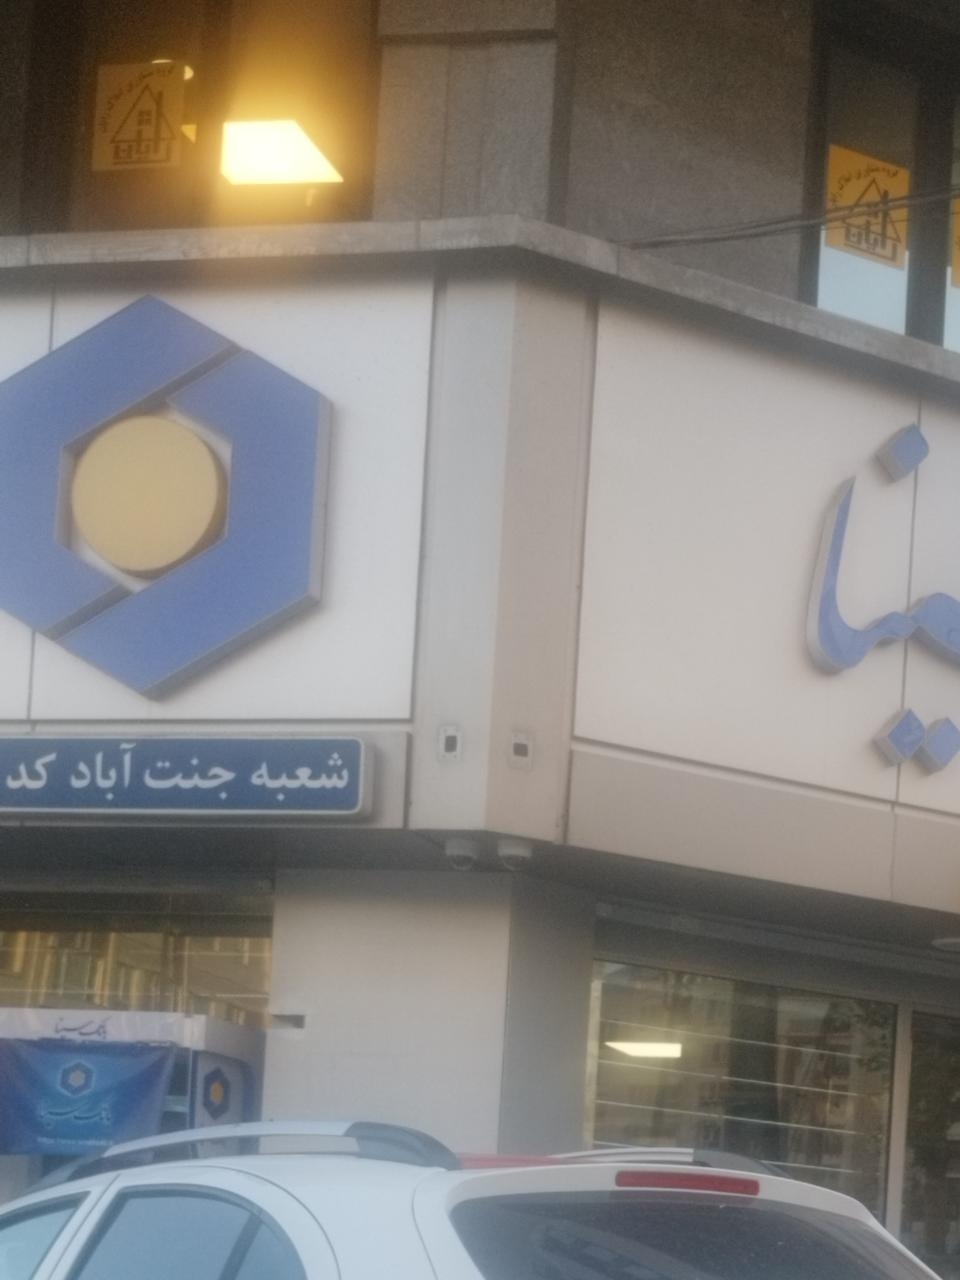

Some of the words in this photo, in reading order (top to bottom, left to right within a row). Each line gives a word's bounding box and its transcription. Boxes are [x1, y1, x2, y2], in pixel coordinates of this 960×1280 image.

[6, 752, 57, 791] کد
[70, 742, 137, 801] آباد
[143, 755, 236, 801] جنت
[250, 751, 349, 802] شعبه
